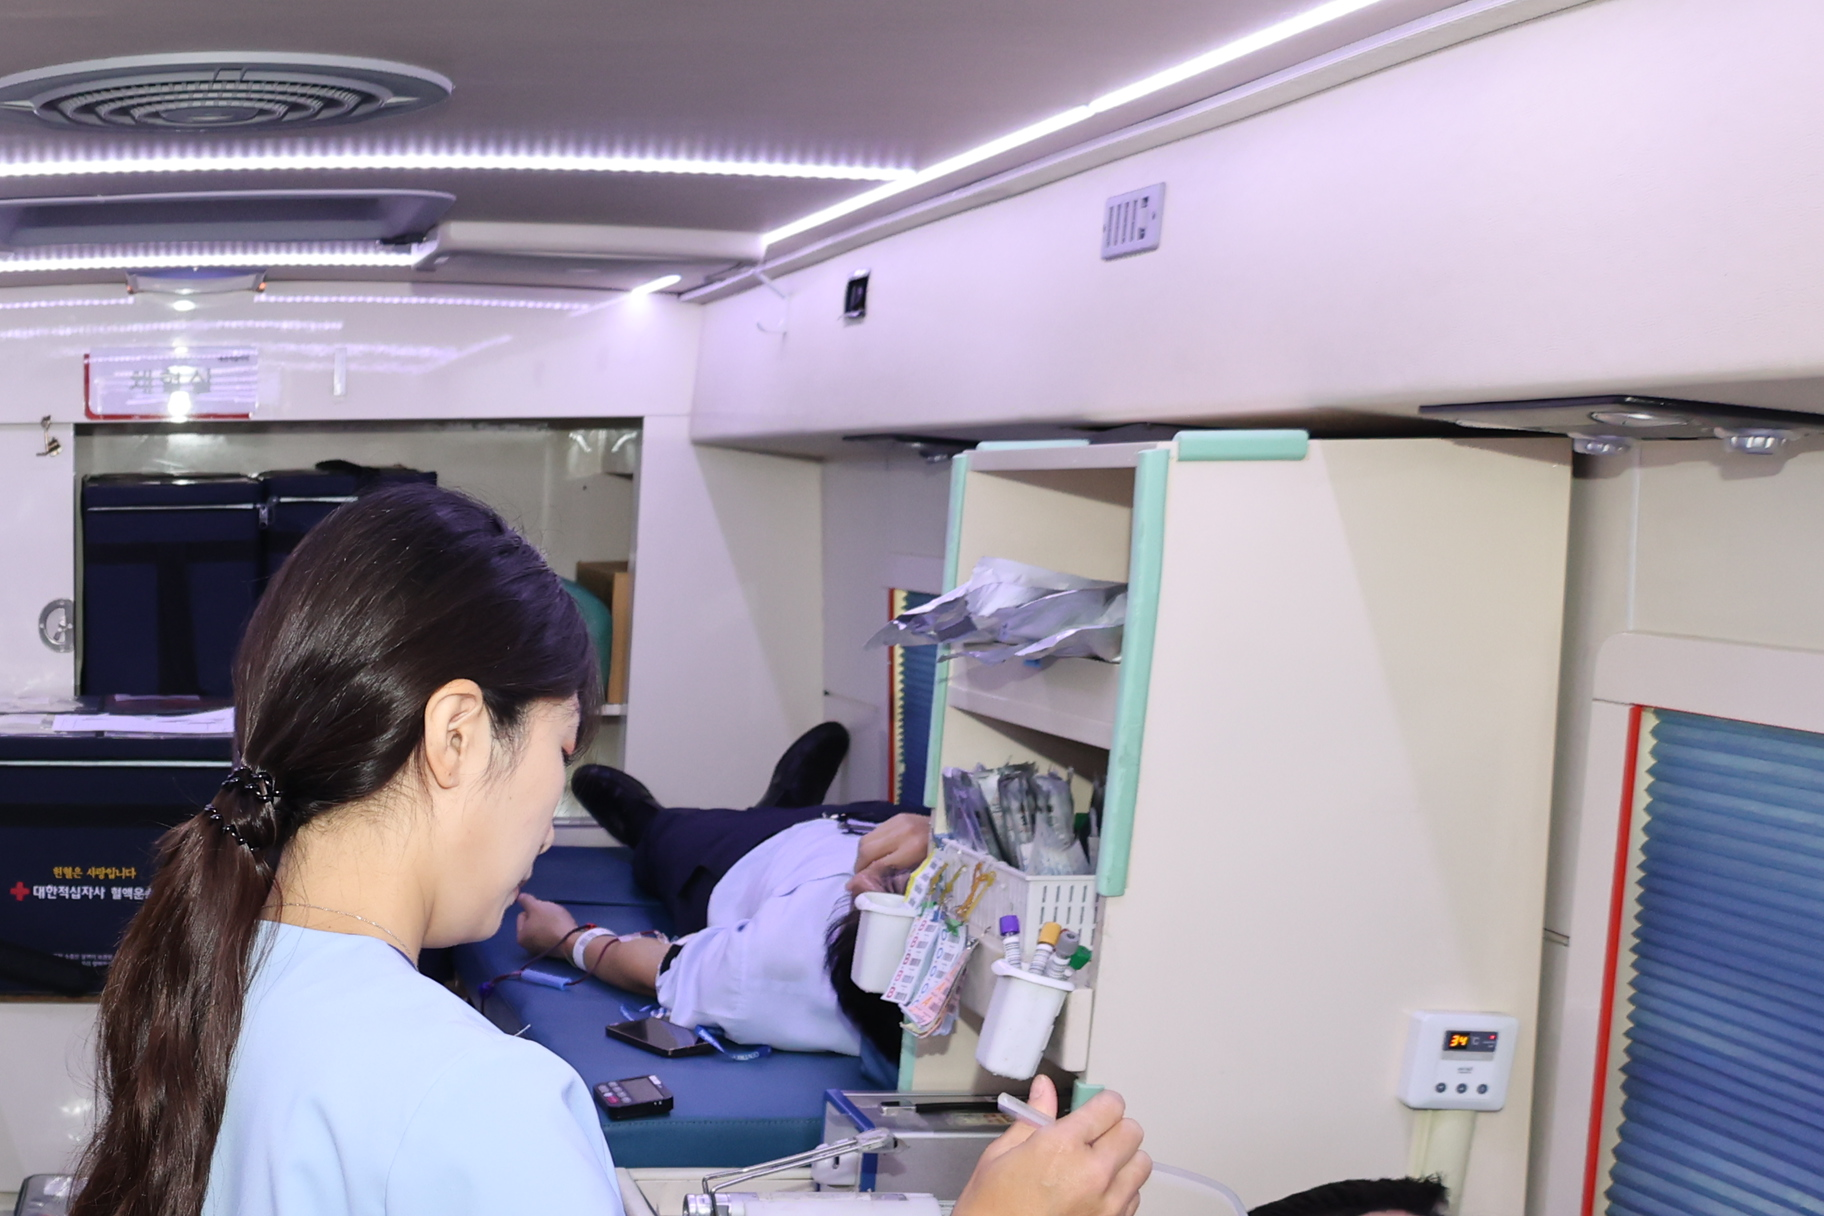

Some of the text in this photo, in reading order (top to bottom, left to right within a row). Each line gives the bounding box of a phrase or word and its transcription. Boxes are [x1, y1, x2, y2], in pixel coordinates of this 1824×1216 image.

[52, 866, 137, 880] 헌혈은 사랑입니다
[32, 884, 106, 900] 대한적십자사
[1449, 1034, 1469, 1047] 34
